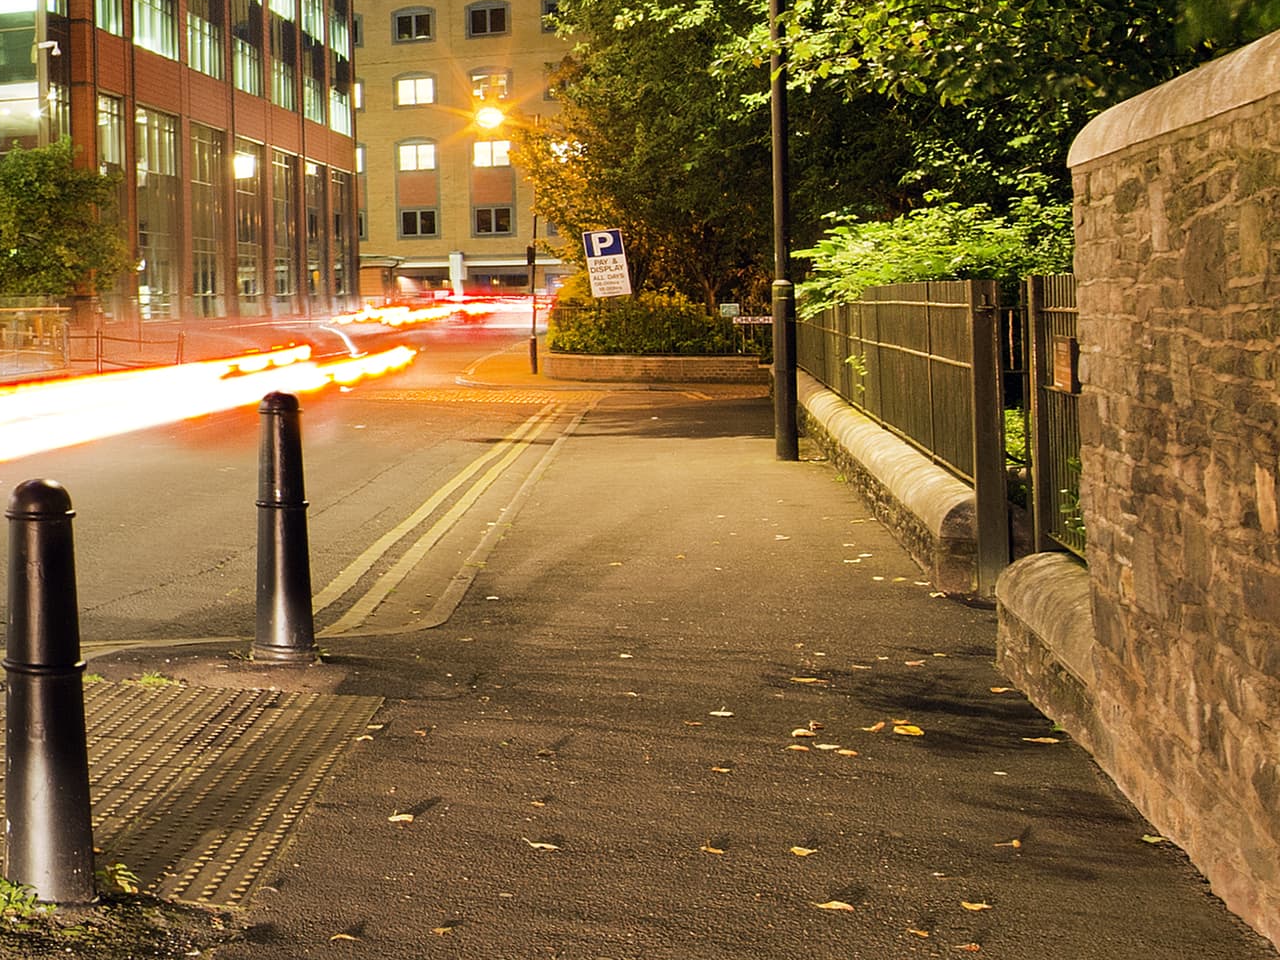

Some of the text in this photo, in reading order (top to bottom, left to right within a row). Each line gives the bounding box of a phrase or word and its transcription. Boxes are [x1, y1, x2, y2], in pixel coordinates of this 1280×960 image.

[591, 232, 614, 256] P
[591, 264, 624, 273] DISPLAY
[734, 316, 773, 324] CHURCH
